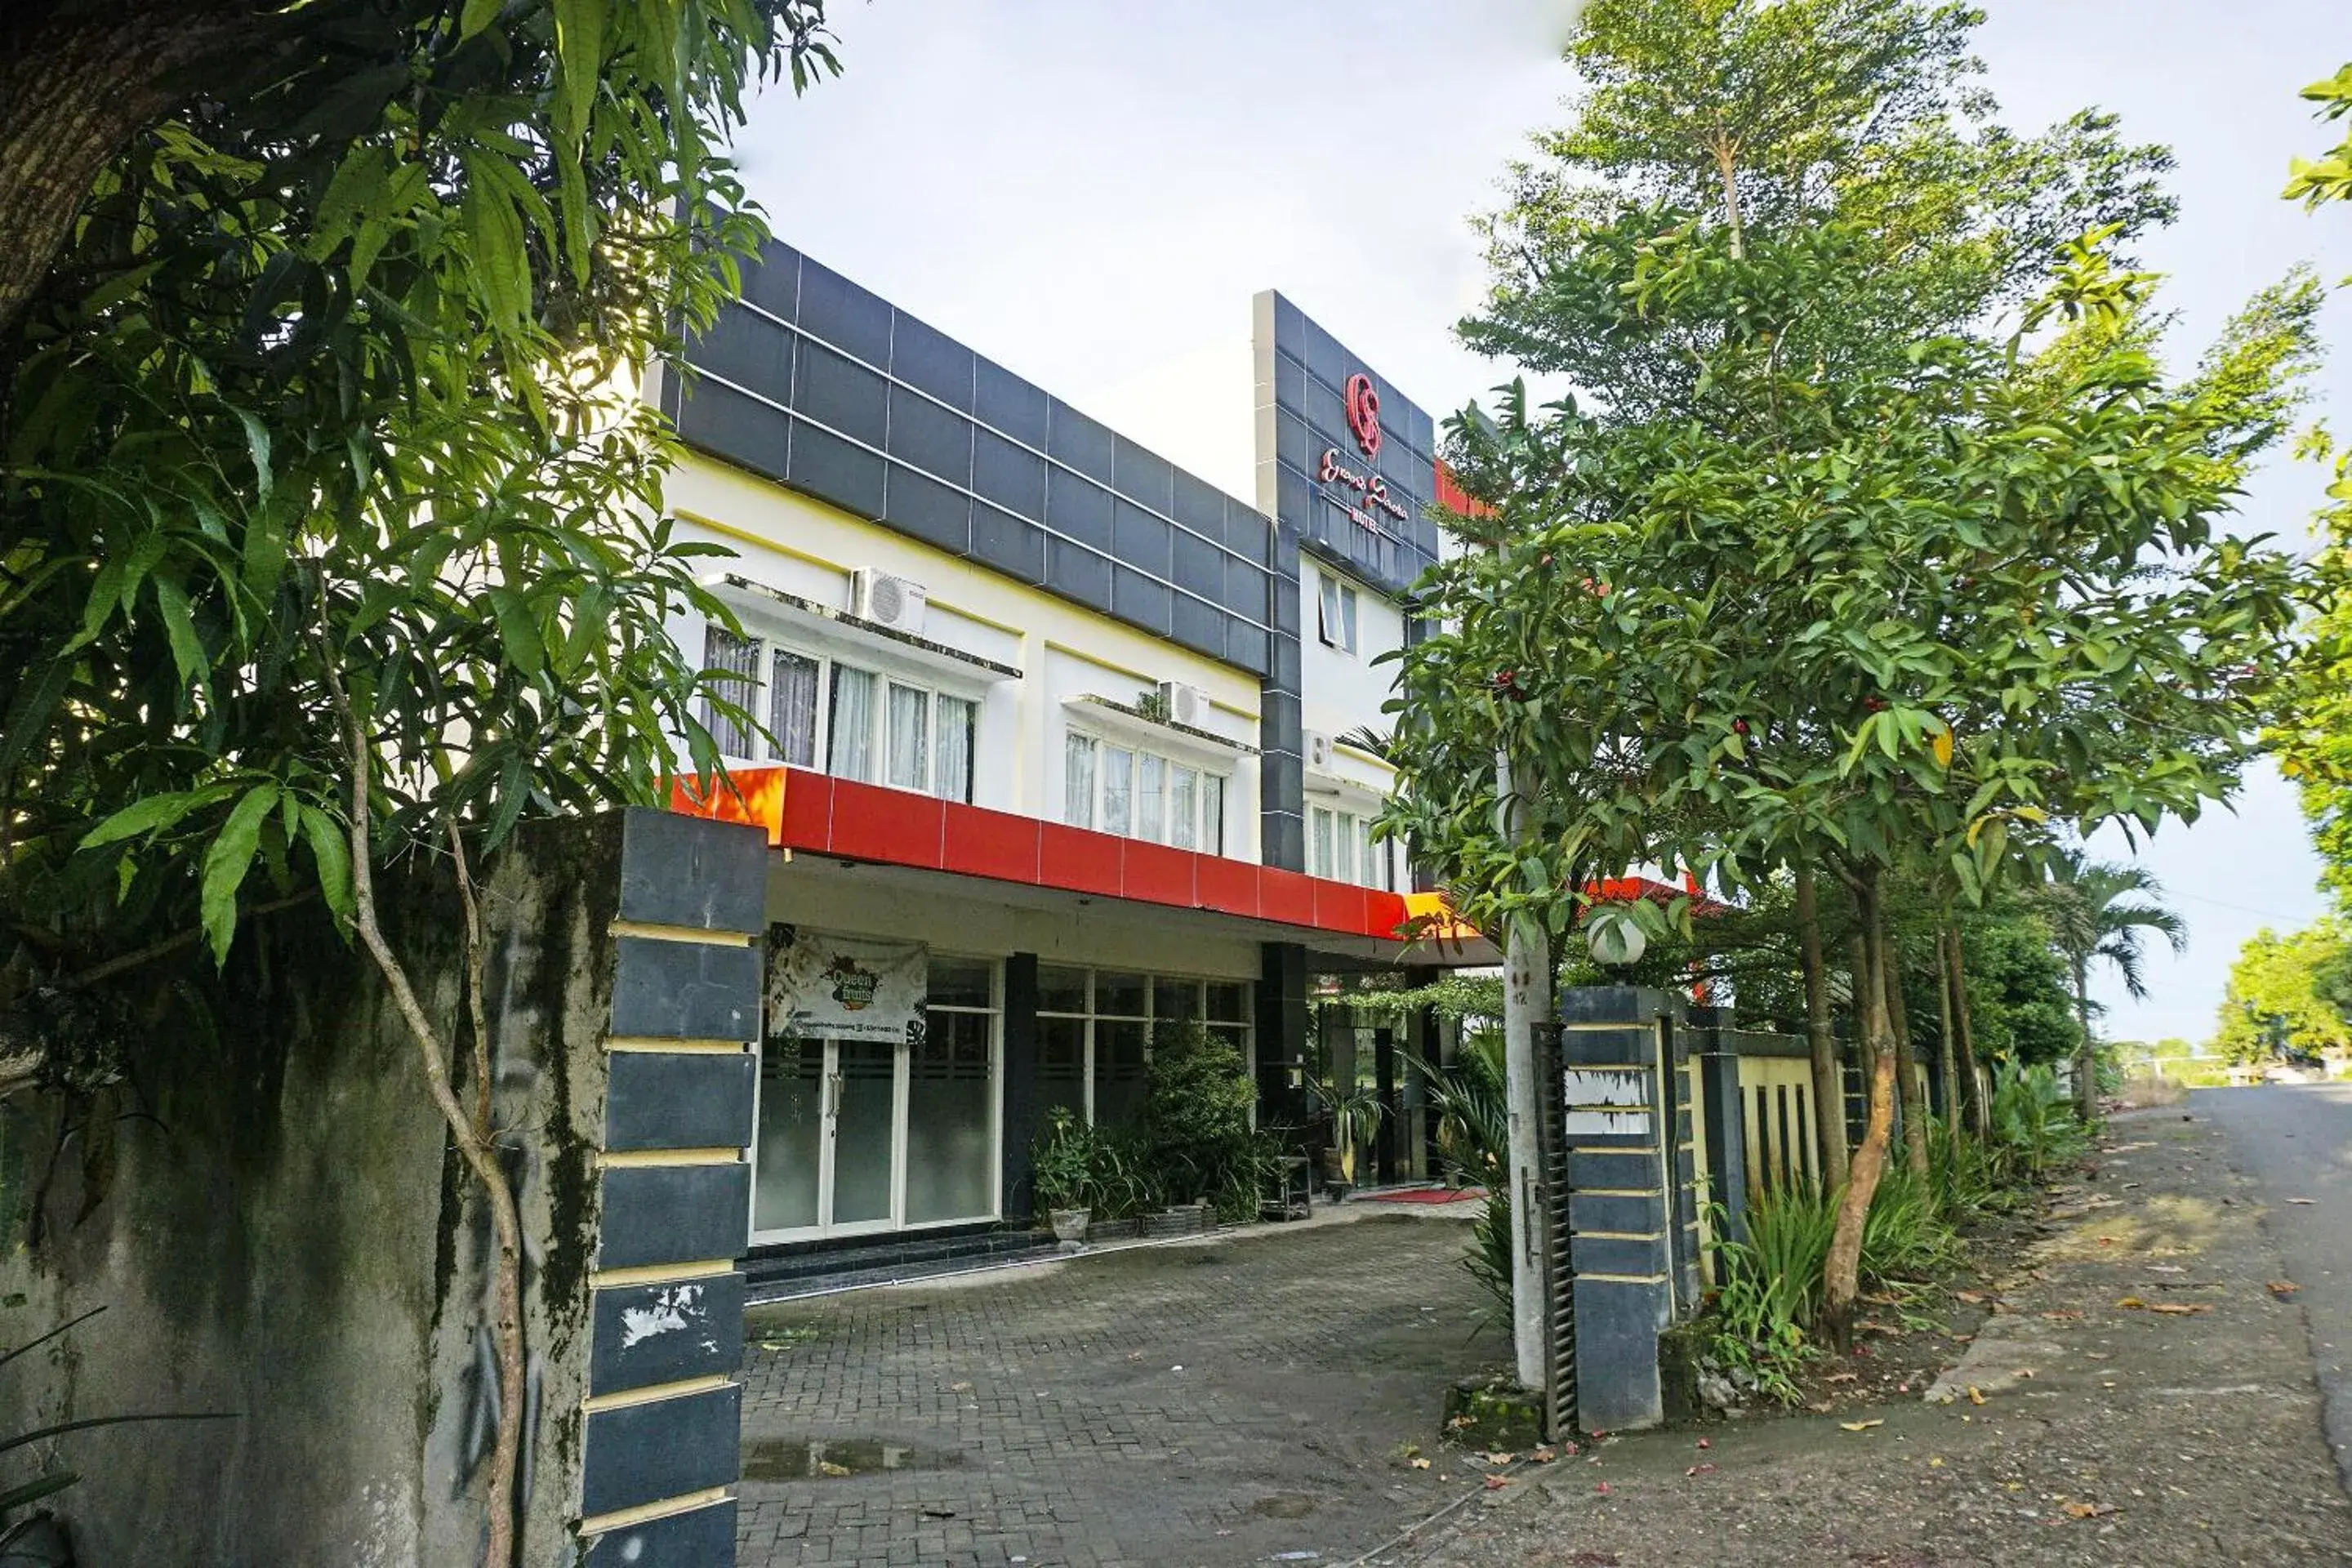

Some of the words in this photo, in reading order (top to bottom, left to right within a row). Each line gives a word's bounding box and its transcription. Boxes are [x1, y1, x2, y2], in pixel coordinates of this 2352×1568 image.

[1321, 448, 1366, 491] Grand
[1351, 507, 1379, 535] HOTEL
[834, 969, 871, 987] Queen
